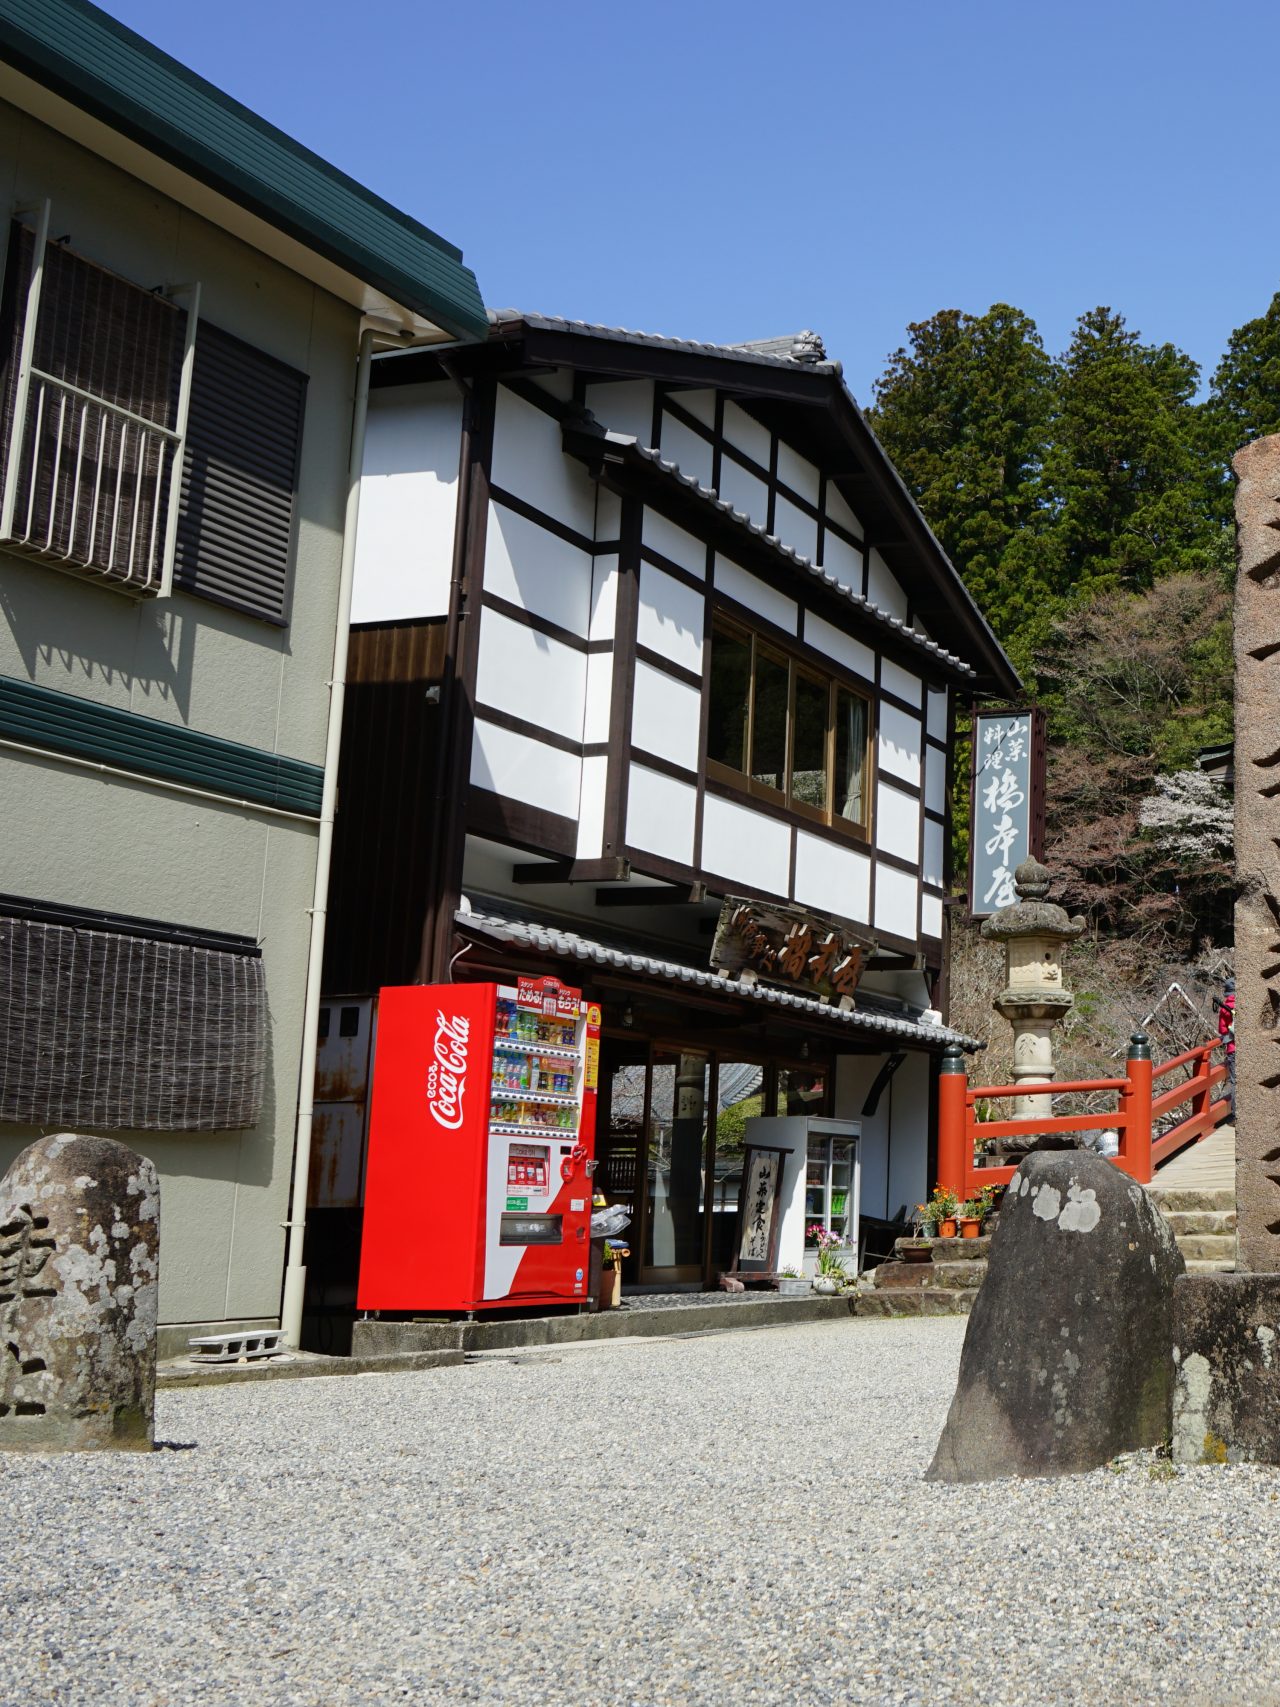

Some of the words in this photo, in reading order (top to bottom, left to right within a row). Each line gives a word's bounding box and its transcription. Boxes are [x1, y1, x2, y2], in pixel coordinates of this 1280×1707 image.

[984, 724, 1006, 770] 料理
[1005, 719, 1028, 763] 山菜
[983, 768, 1025, 908] 橋本屋
[429, 1009, 470, 1130] Coca-Cola
[753, 1167, 770, 1233] 山菜定食
